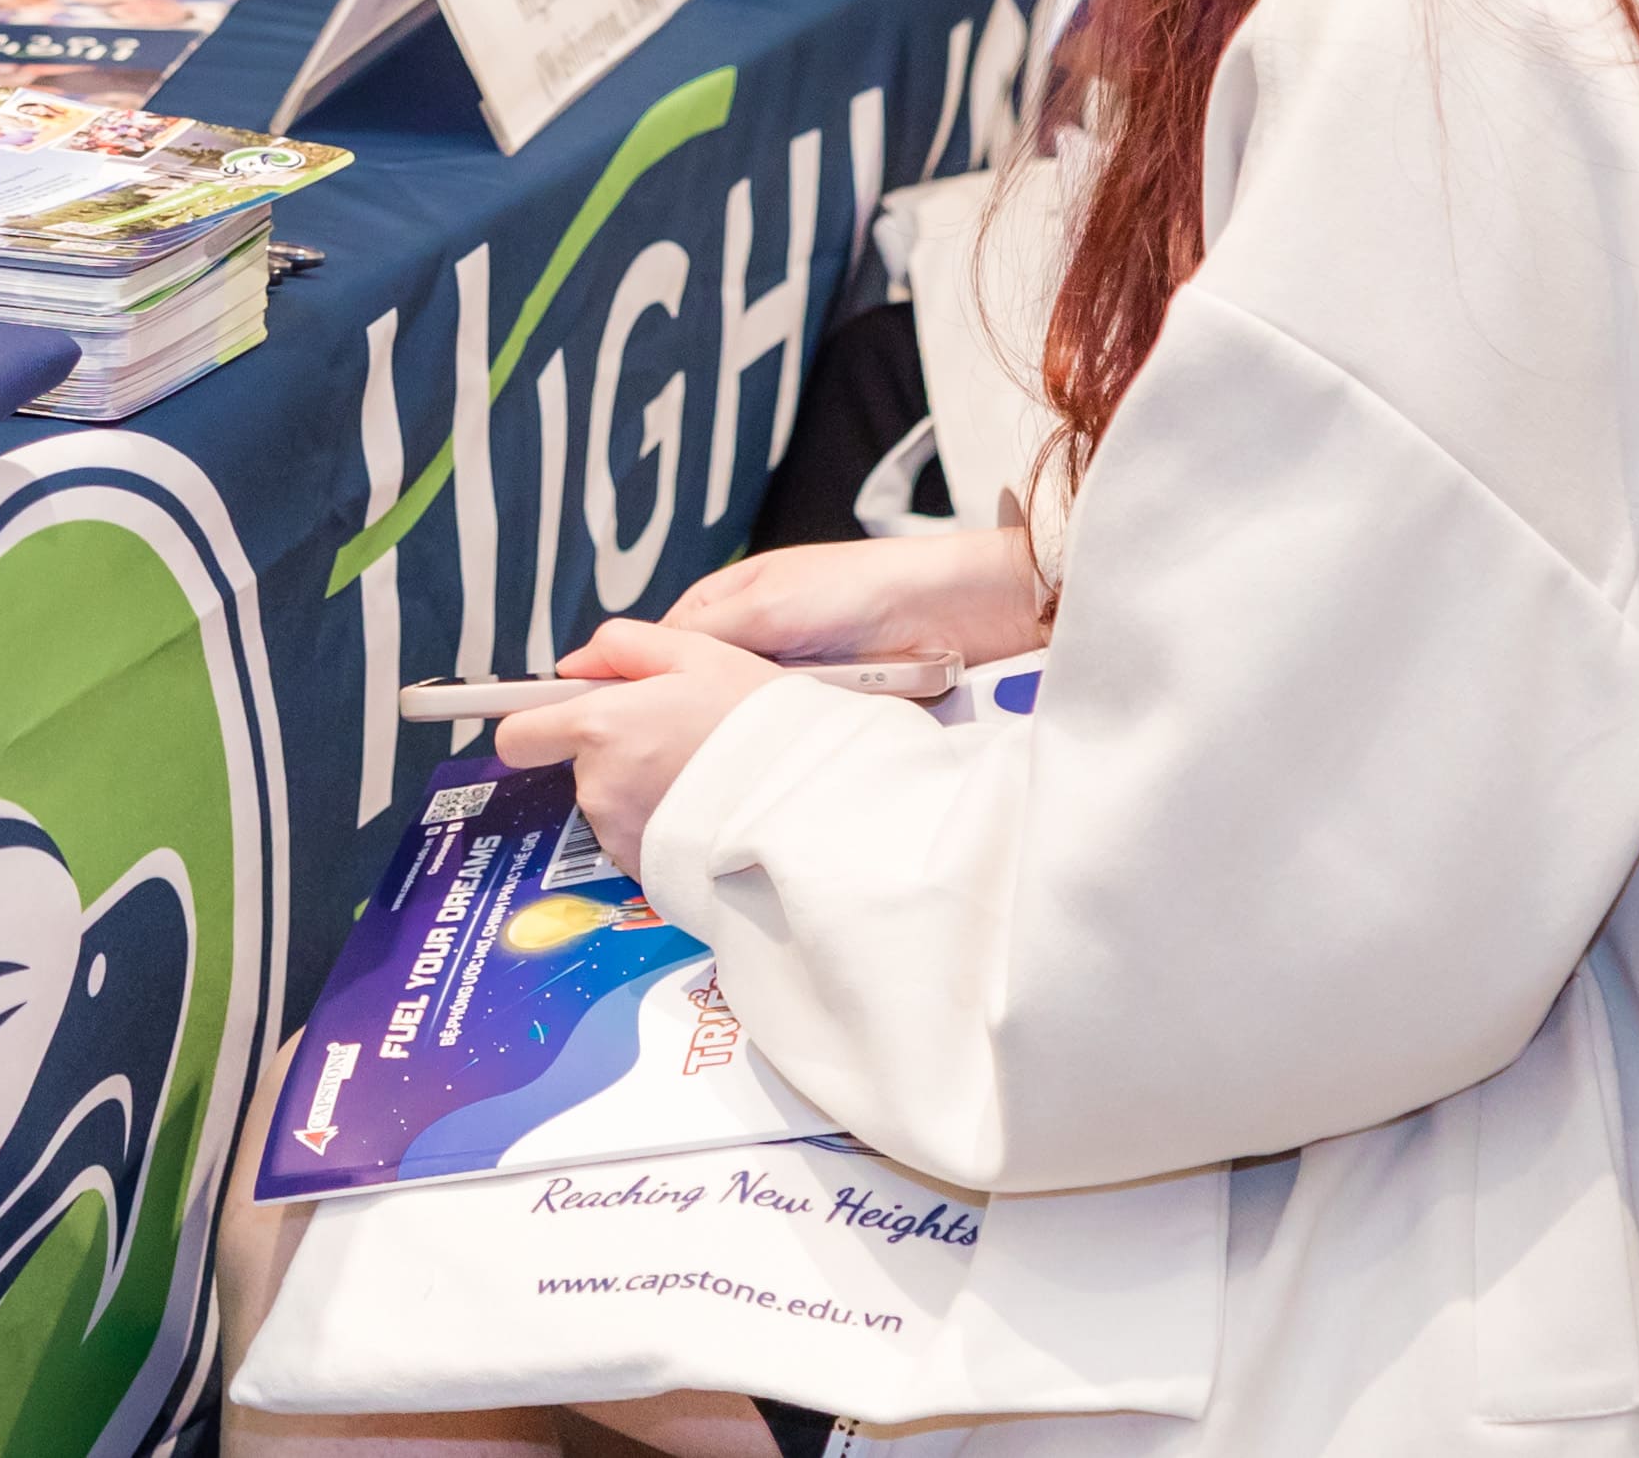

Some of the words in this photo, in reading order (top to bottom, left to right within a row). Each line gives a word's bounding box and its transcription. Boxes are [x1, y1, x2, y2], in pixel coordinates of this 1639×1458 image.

[379, 993, 431, 1060] FUEL
[405, 926, 459, 992] YOUR
[436, 834, 503, 923] DREAMS
[308, 1043, 351, 1131] CAPSTONE
[530, 1174, 708, 1215] Reaching
[719, 1169, 815, 1215] New
[825, 1185, 980, 1247] Heights
[536, 1268, 904, 1335] www.capstone.edu.vn
